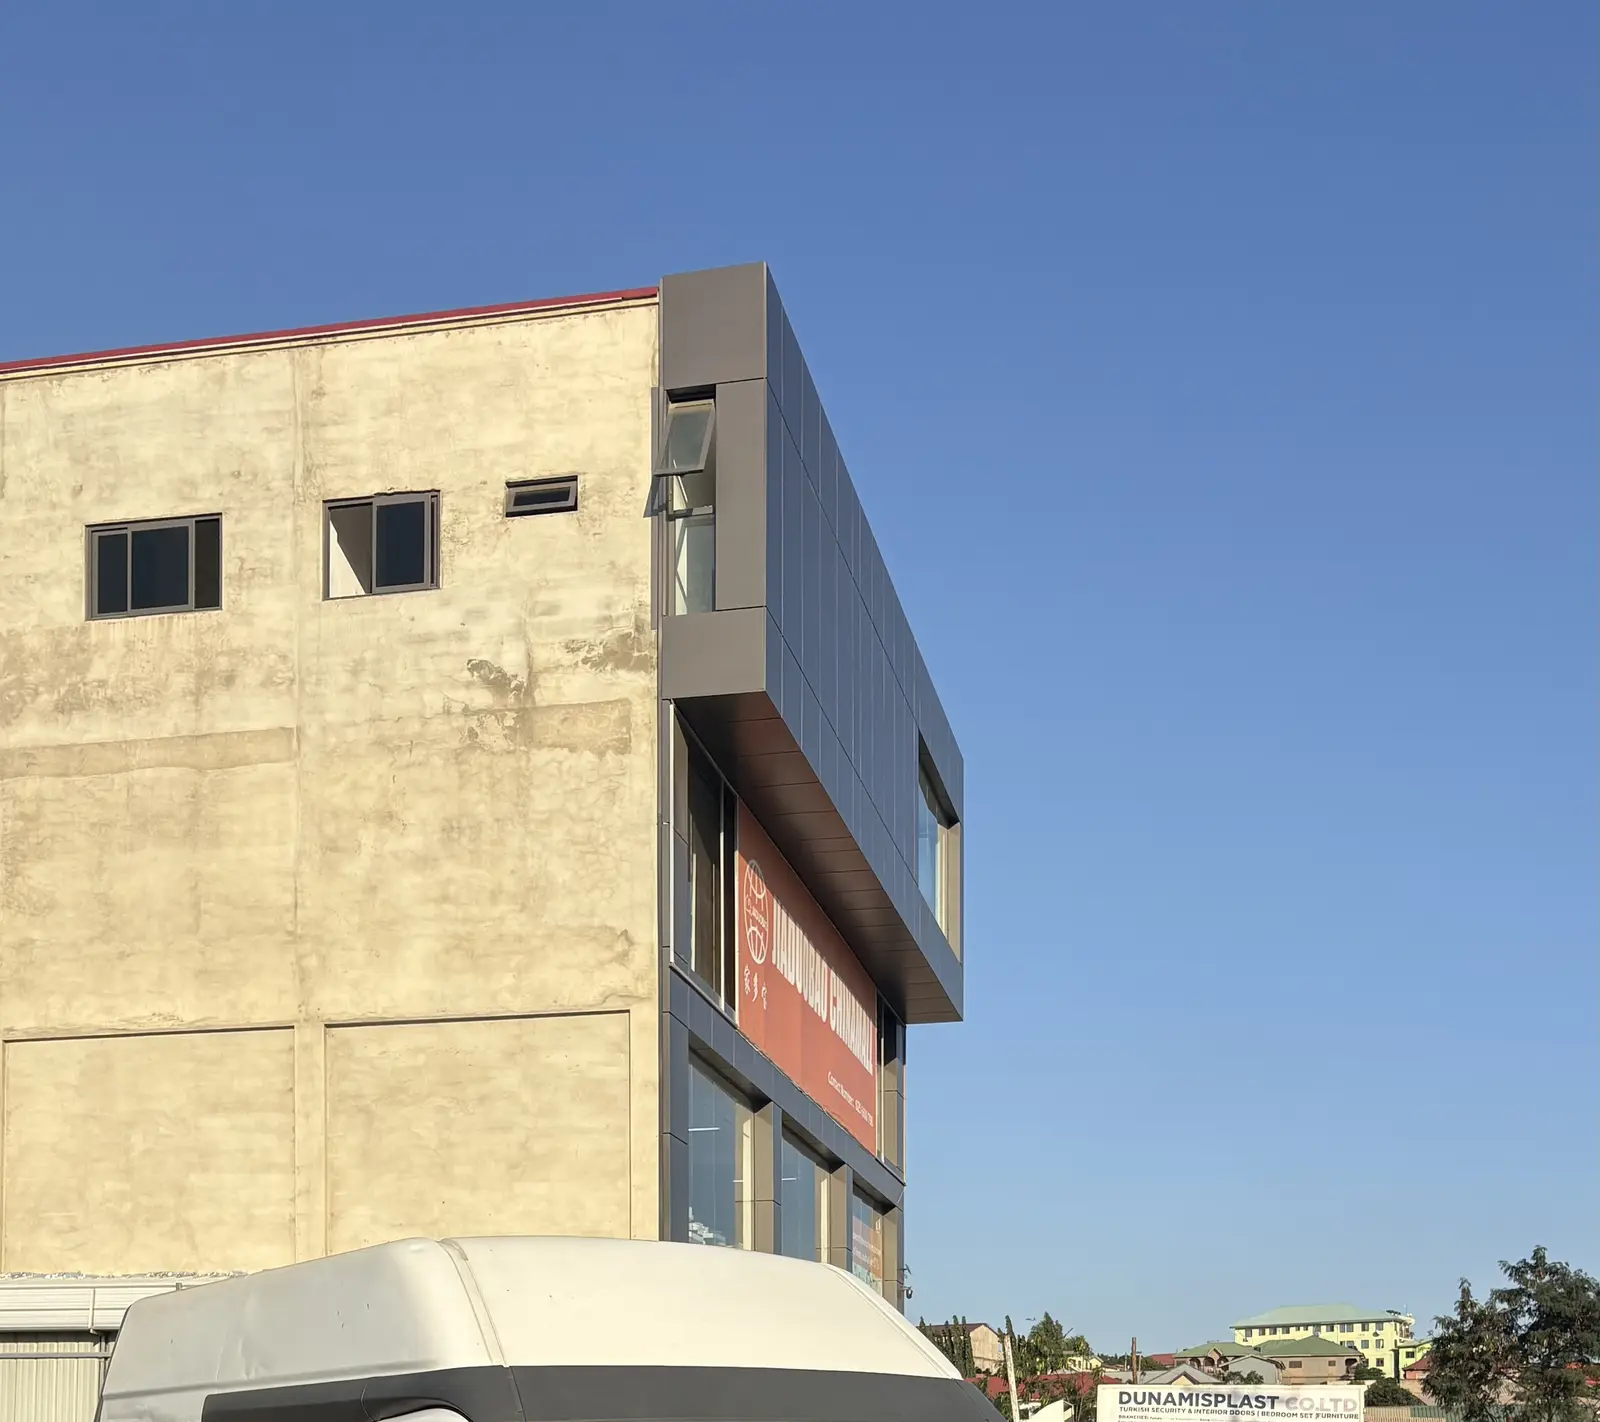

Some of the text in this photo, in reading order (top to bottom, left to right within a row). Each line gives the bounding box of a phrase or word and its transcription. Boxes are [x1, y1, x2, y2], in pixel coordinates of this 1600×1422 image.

[1118, 1391, 1358, 1413] DUNAMISPLAST CO.LTD
[1261, 1411, 1298, 1419] BEDROOM
